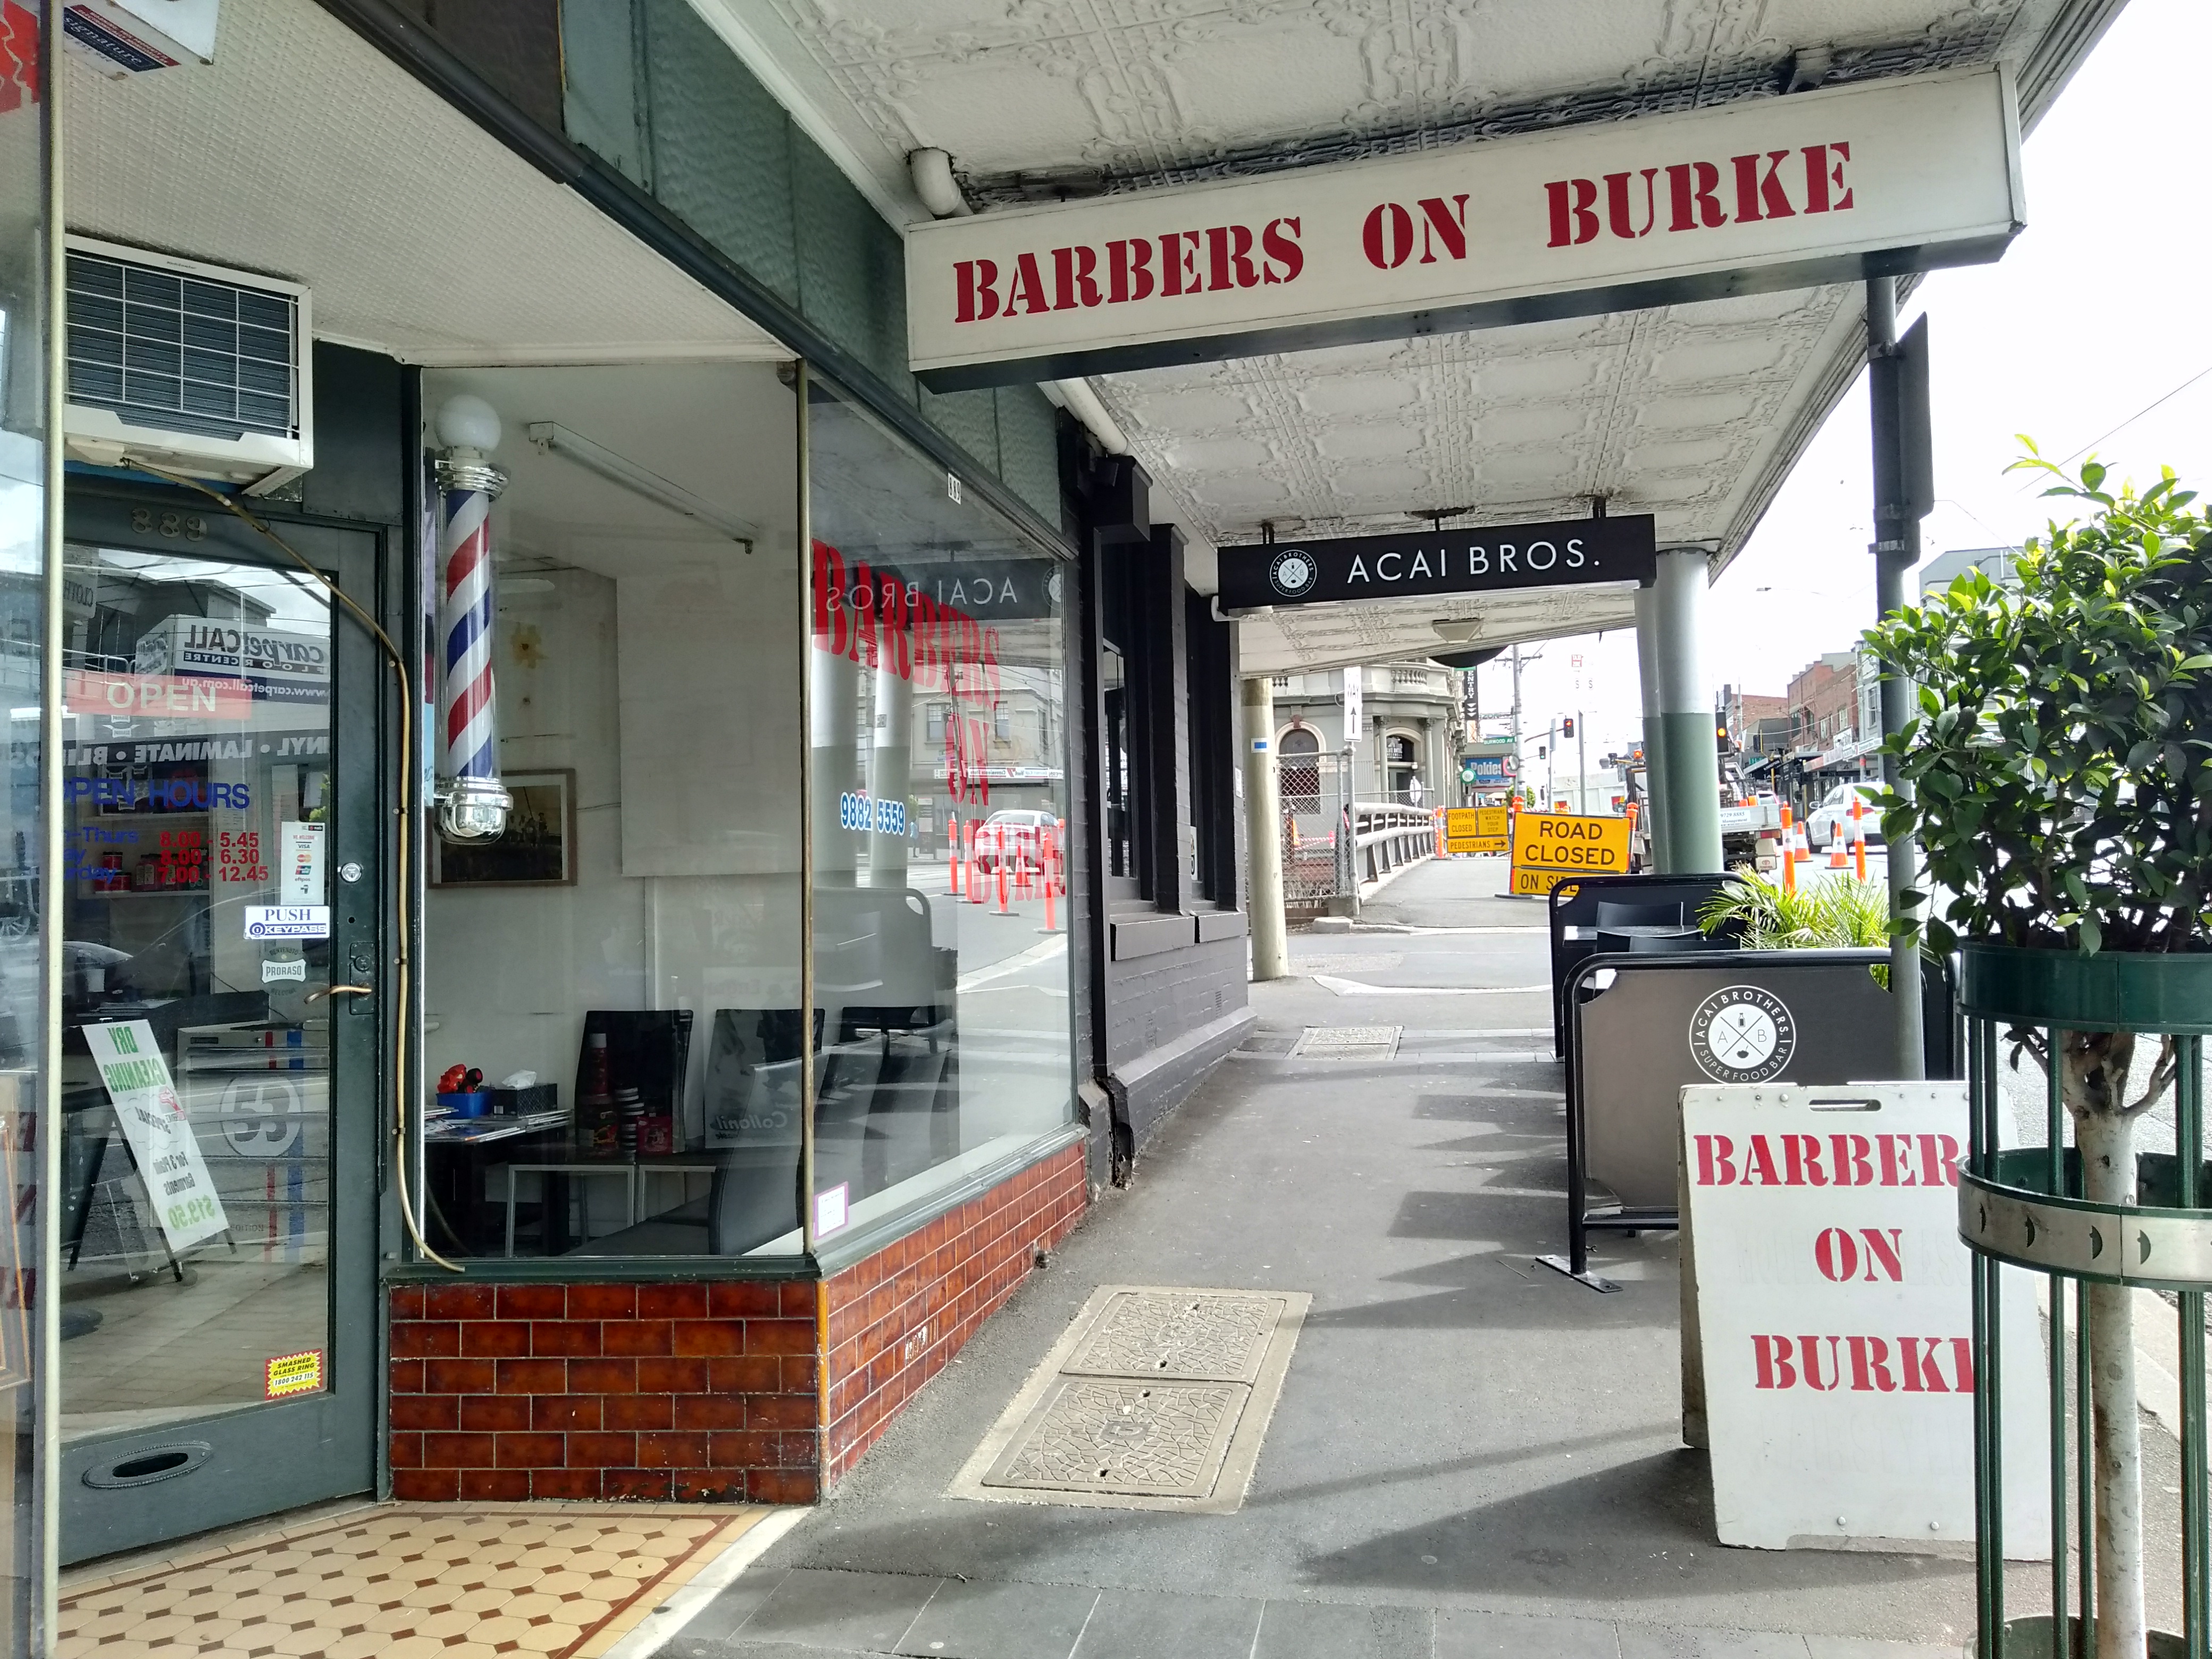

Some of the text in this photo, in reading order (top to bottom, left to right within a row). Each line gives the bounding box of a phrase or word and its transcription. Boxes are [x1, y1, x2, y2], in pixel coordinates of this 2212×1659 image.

[64, 17, 142, 65] signature
[954, 142, 1853, 323] BARBERS ON BURKE
[949, 477, 960, 500] 889
[132, 508, 207, 541] 889
[1347, 539, 1600, 583] ACAI BROS.
[811, 538, 1000, 711] BARBERS
[1467, 671, 1475, 699] ENTRY
[107, 682, 216, 712] OPEN
[945, 711, 990, 806] ON
[149, 780, 250, 809] HOURS
[841, 792, 905, 836] 9882 5559
[1452, 824, 1472, 833] CLOSED
[1540, 820, 1603, 840] ROAD
[160, 831, 201, 847] 8.00
[220, 832, 259, 848] 5.45
[1451, 840, 1490, 849] PEDESTRIANS
[161, 848, 202, 866] 8.00
[220, 849, 259, 865] 6.30
[1525, 844, 1615, 865] CLOSED
[158, 866, 200, 883] 7.00
[219, 866, 269, 882] 12.45
[1520, 874, 1539, 890] ON
[264, 908, 312, 921] PUSH
[266, 925, 326, 934] KEYPASS
[266, 965, 302, 977] PRORASO
[1696, 1002, 1718, 1037] ACAI
[1717, 1030, 1728, 1044] A
[1757, 1029, 1767, 1042] B
[1769, 1048, 1788, 1069] BAR
[233, 1085, 291, 1142] 53
[1693, 1134, 2001, 1186] BARBER
[1814, 1227, 1903, 1283] ON
[273, 1367, 296, 1376] GLASS
[277, 1357, 312, 1369] SMASHED
[275, 1377, 290, 1386] 1800
